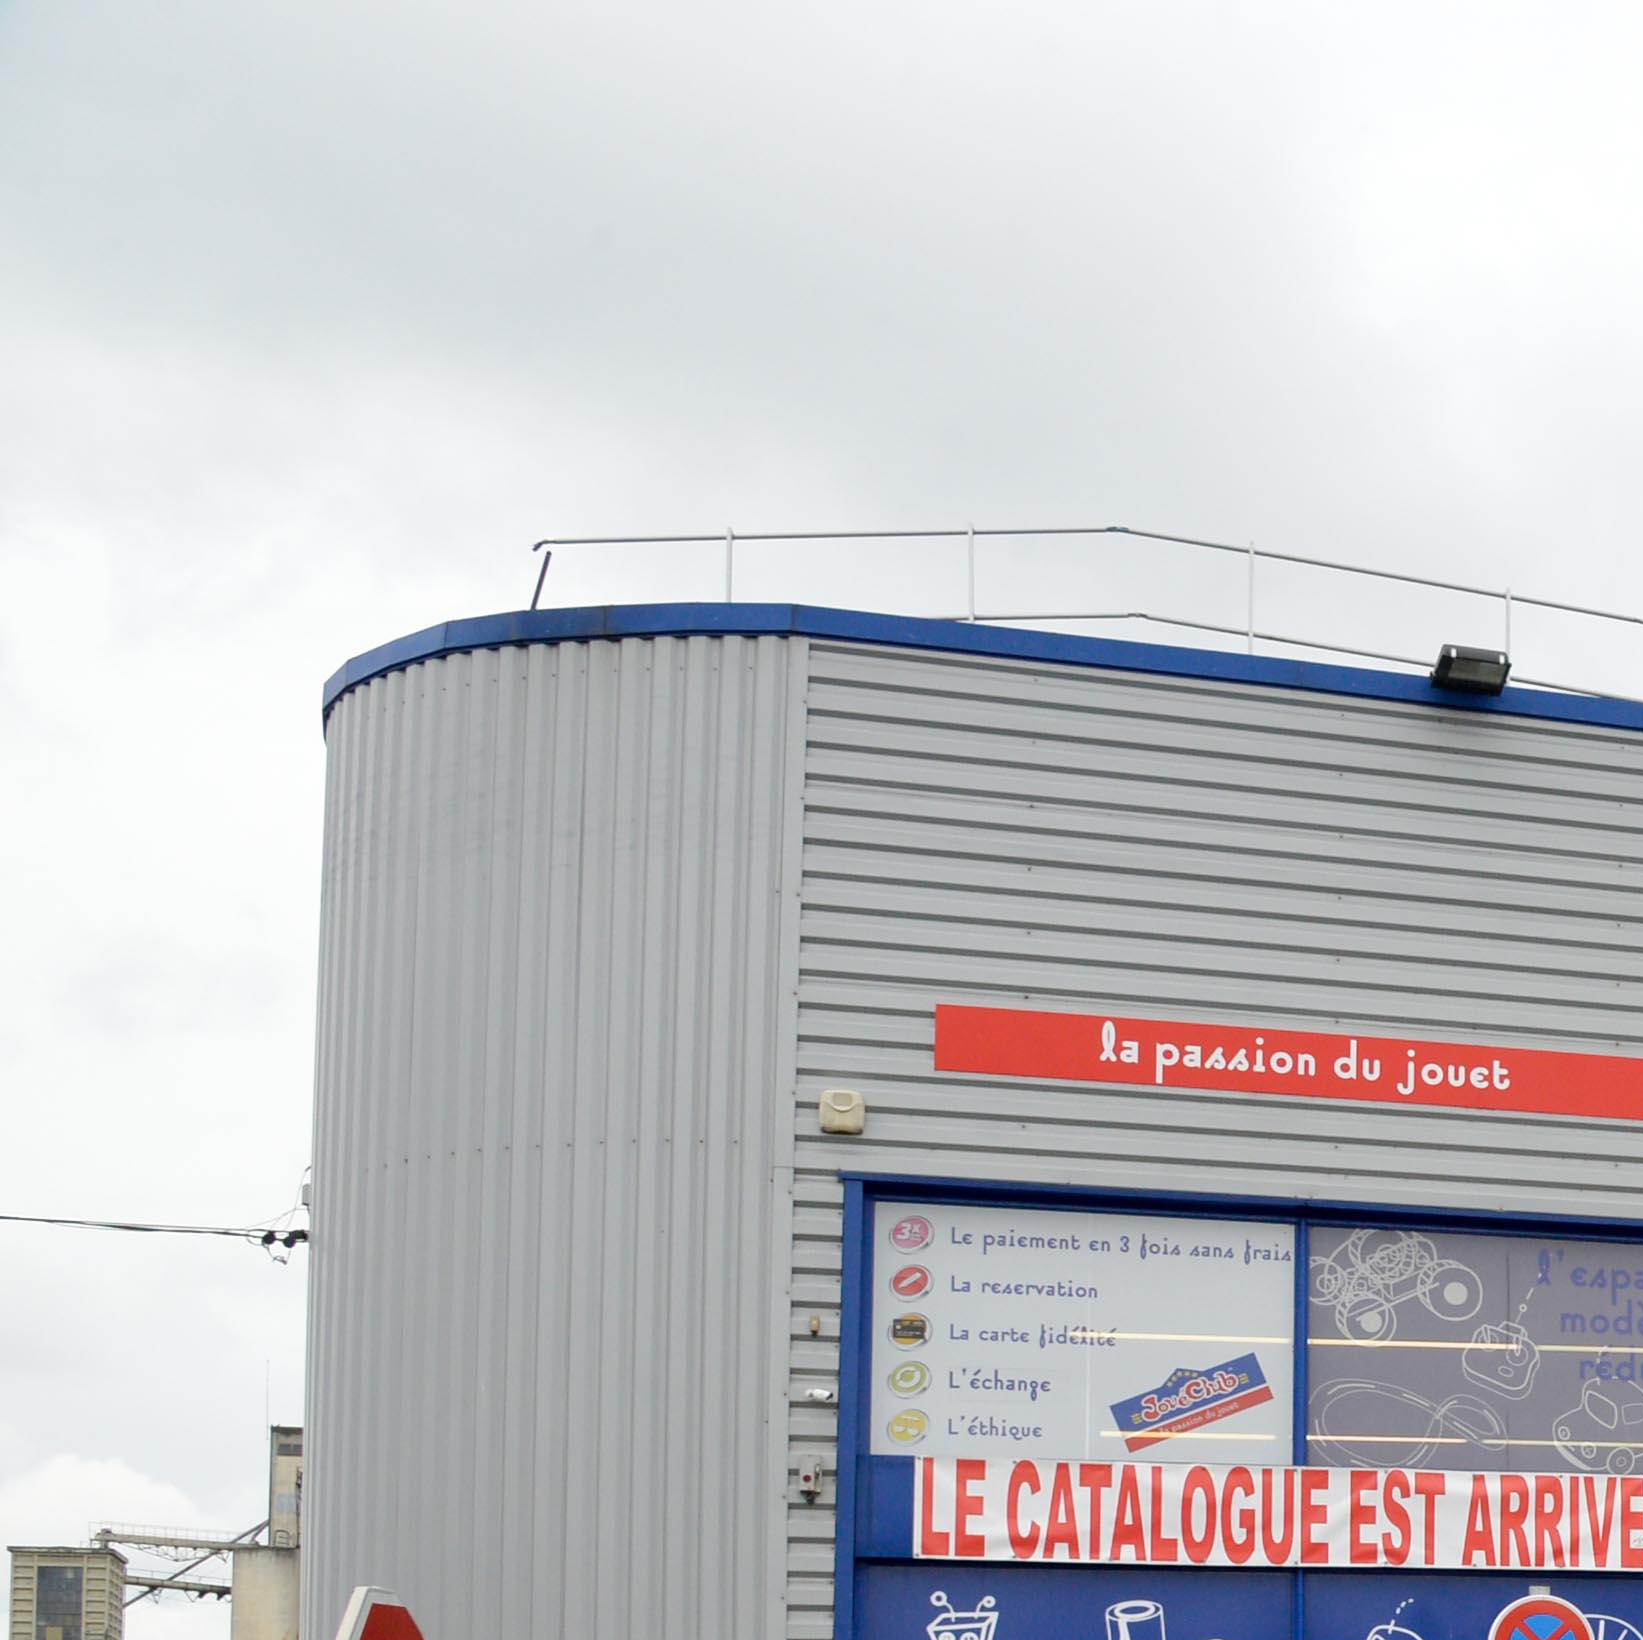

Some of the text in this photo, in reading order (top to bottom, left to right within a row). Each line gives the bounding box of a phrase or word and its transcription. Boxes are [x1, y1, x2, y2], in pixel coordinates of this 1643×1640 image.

[1100, 1020, 1511, 1095] la passion du jouet
[951, 1227, 1292, 1265] Le paiement en 3 fois sans frais
[951, 1276, 1098, 1298] La reservation
[950, 1324, 1117, 1349] La carte fidélité
[949, 1368, 1051, 1401] L'échange
[948, 1416, 1043, 1441] L'éthique
[921, 1457, 986, 1556] LE
[1006, 1459, 1329, 1565] CATALOGUE
[1349, 1469, 1446, 1567] EST
